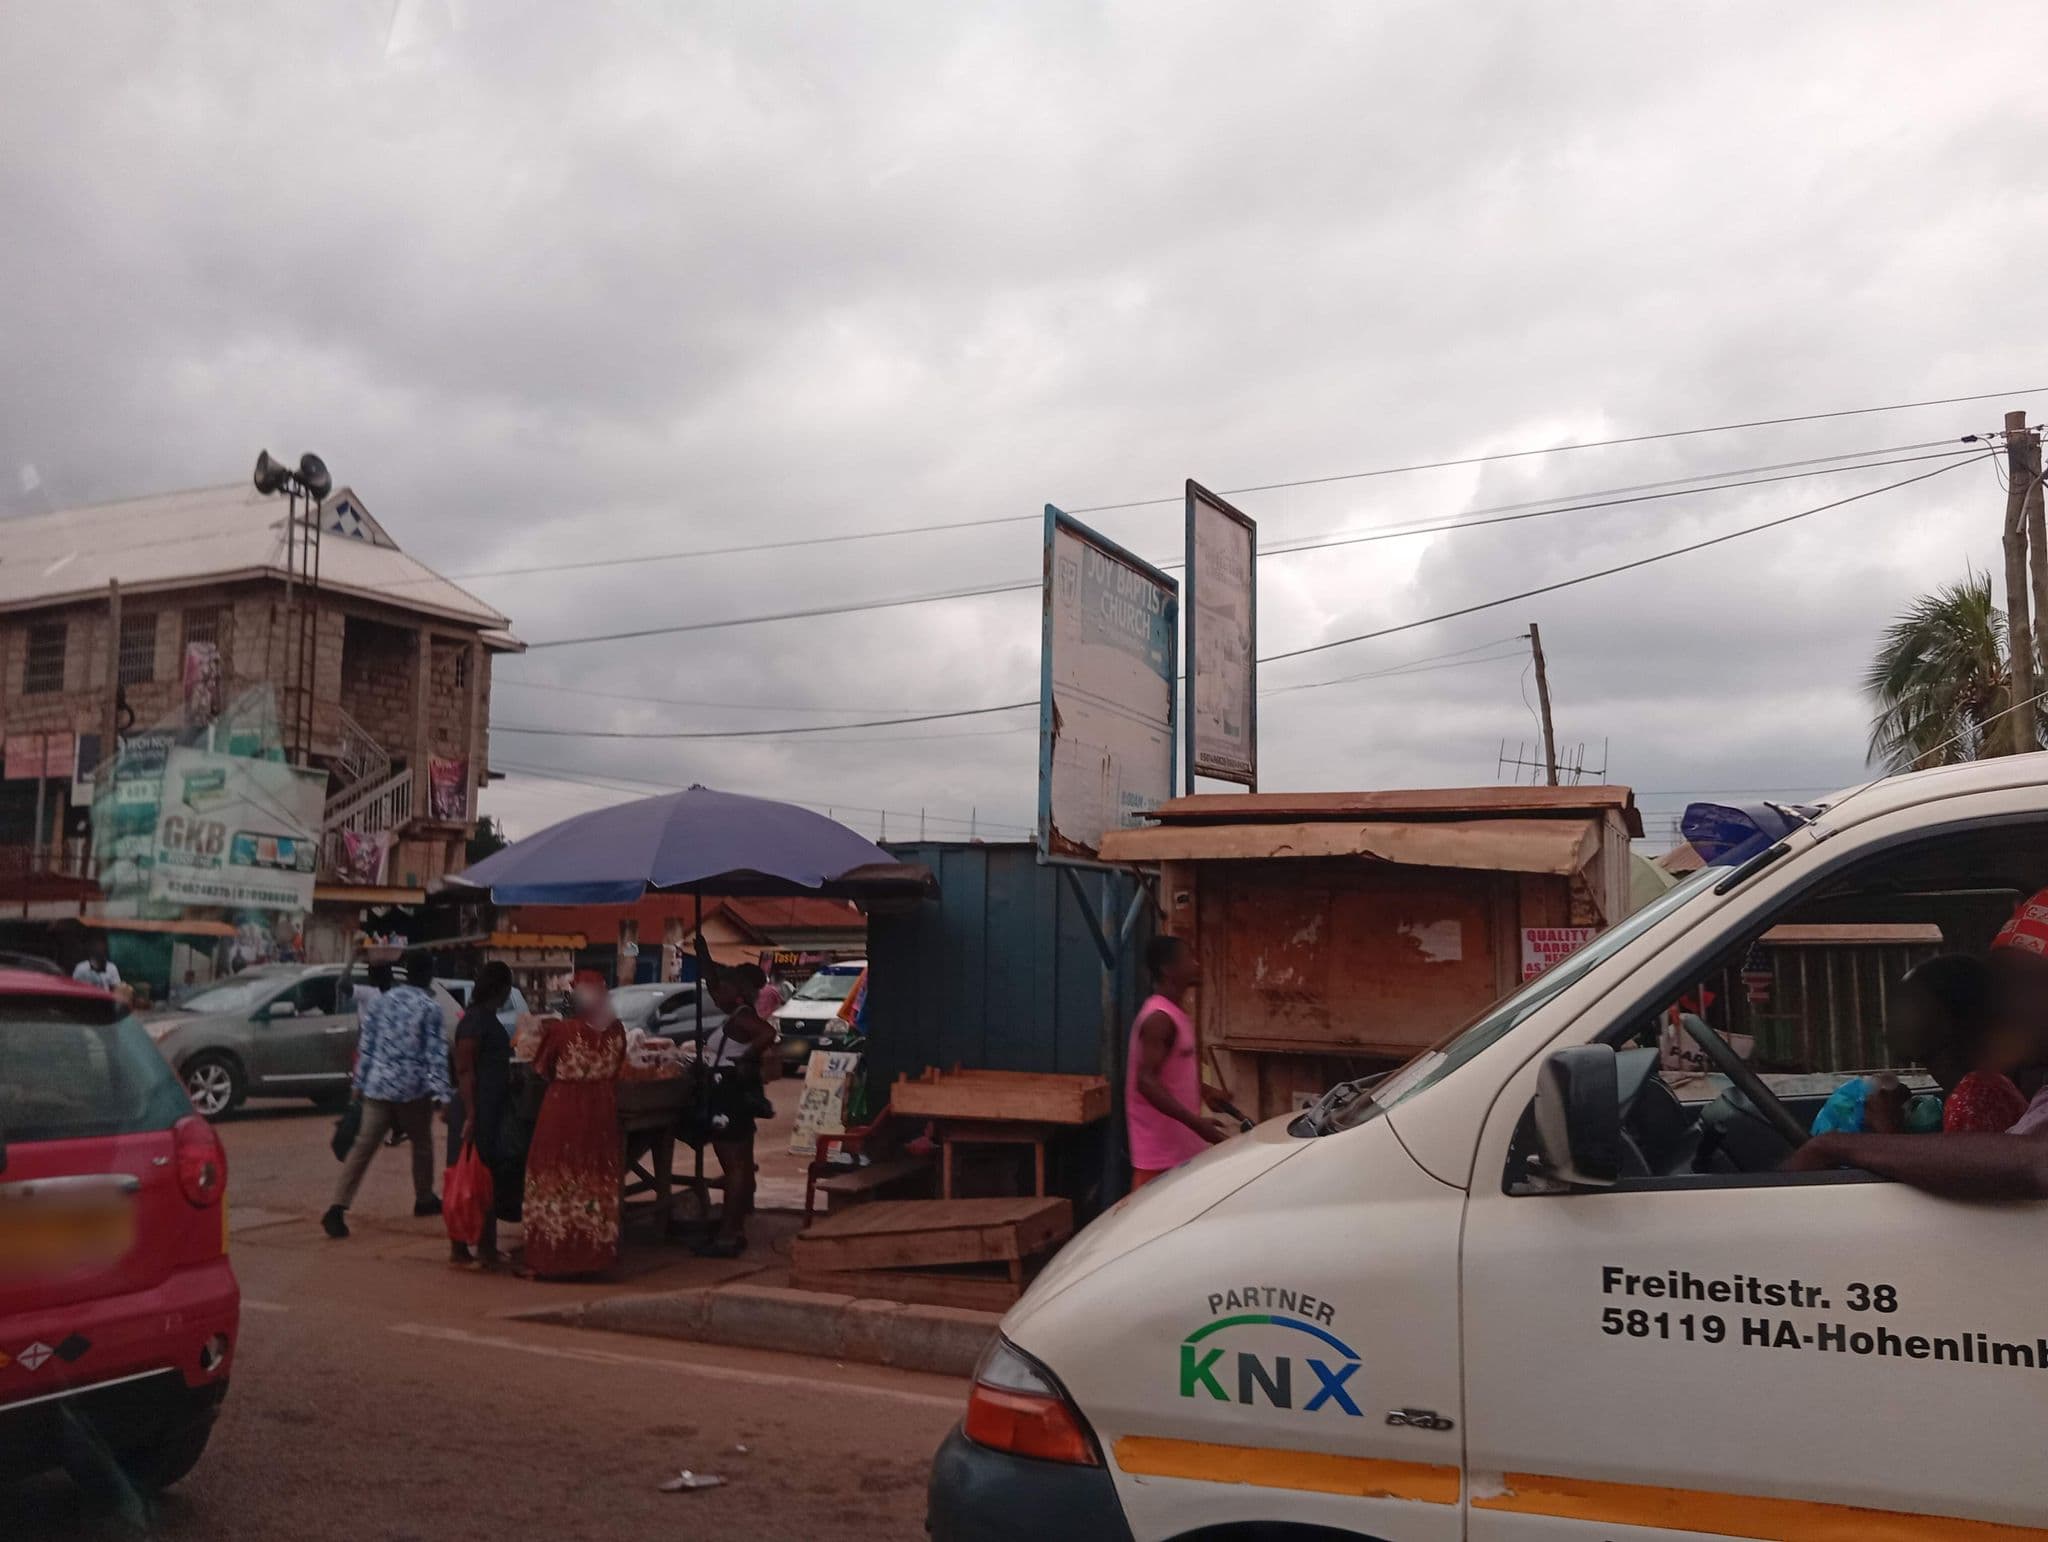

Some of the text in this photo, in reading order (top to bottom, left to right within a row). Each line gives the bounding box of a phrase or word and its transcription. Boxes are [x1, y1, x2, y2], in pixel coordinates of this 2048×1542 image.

[1088, 550, 1114, 589] JOY
[1117, 564, 1169, 616] BAPTIST
[1101, 590, 1151, 641] CHURCH
[163, 815, 226, 855] GKB
[1526, 929, 1589, 942] QUALITY
[774, 951, 799, 967] Tasty
[1208, 1286, 1336, 1326] PARTNER
[1602, 1266, 1898, 1313] Freiheitstr. 38
[1601, 1307, 1726, 1343] 58119
[1180, 1344, 1365, 1417] KNX
